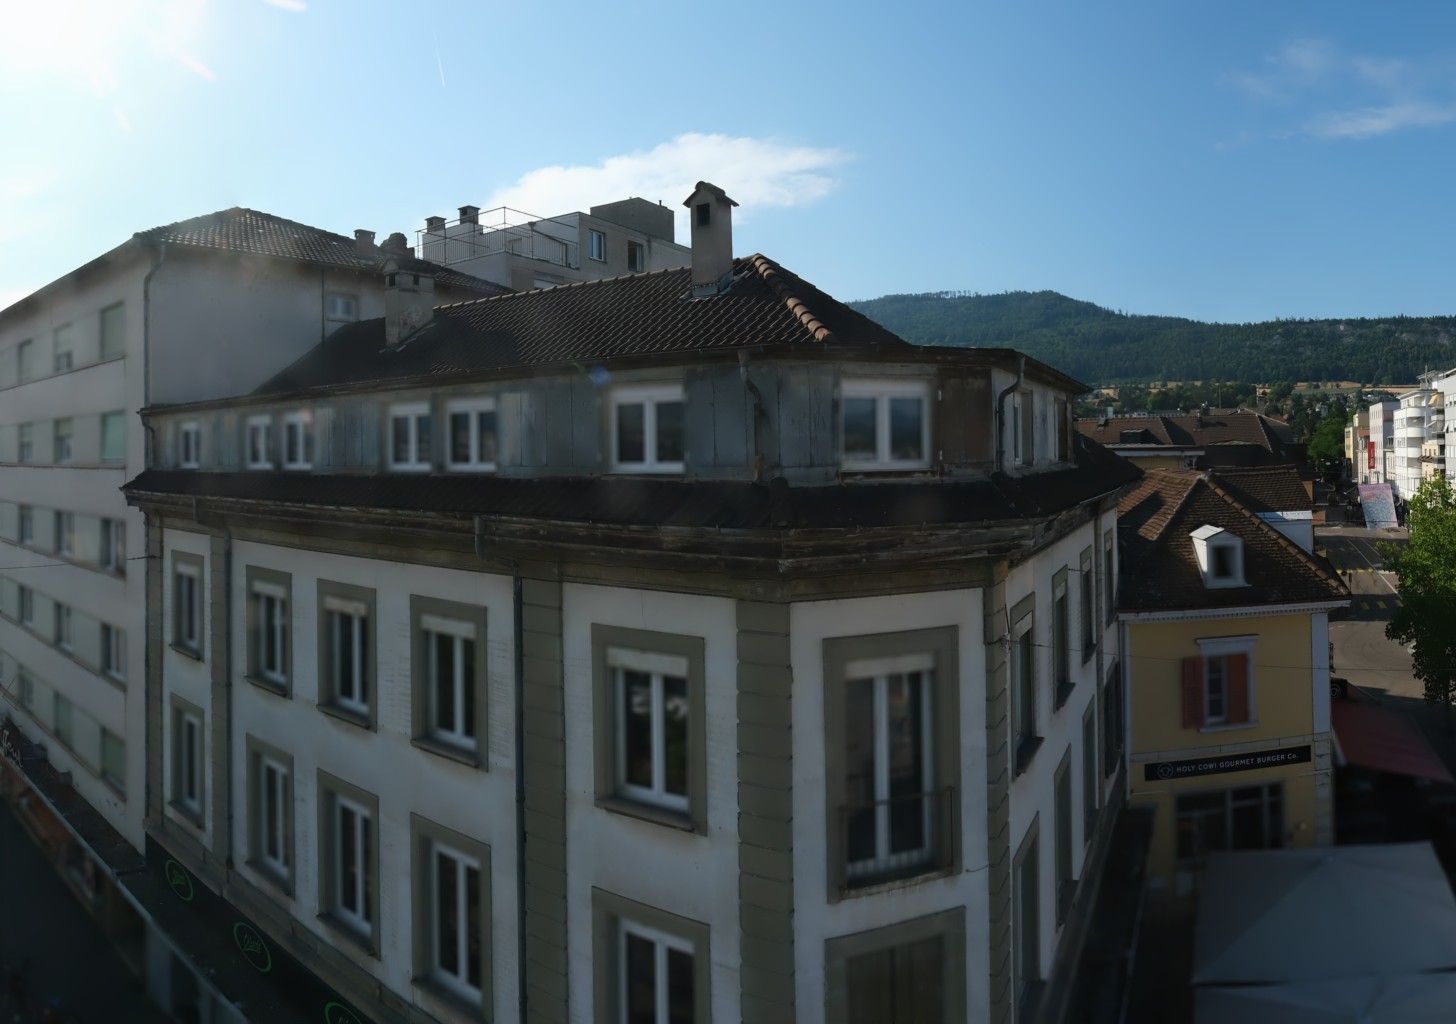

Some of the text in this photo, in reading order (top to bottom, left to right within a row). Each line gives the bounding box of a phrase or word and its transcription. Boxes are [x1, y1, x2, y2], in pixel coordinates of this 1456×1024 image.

[1176, 765, 1196, 773] HOLY
[1219, 758, 1254, 769] GOURMET
[1256, 754, 1286, 764] BURGER
